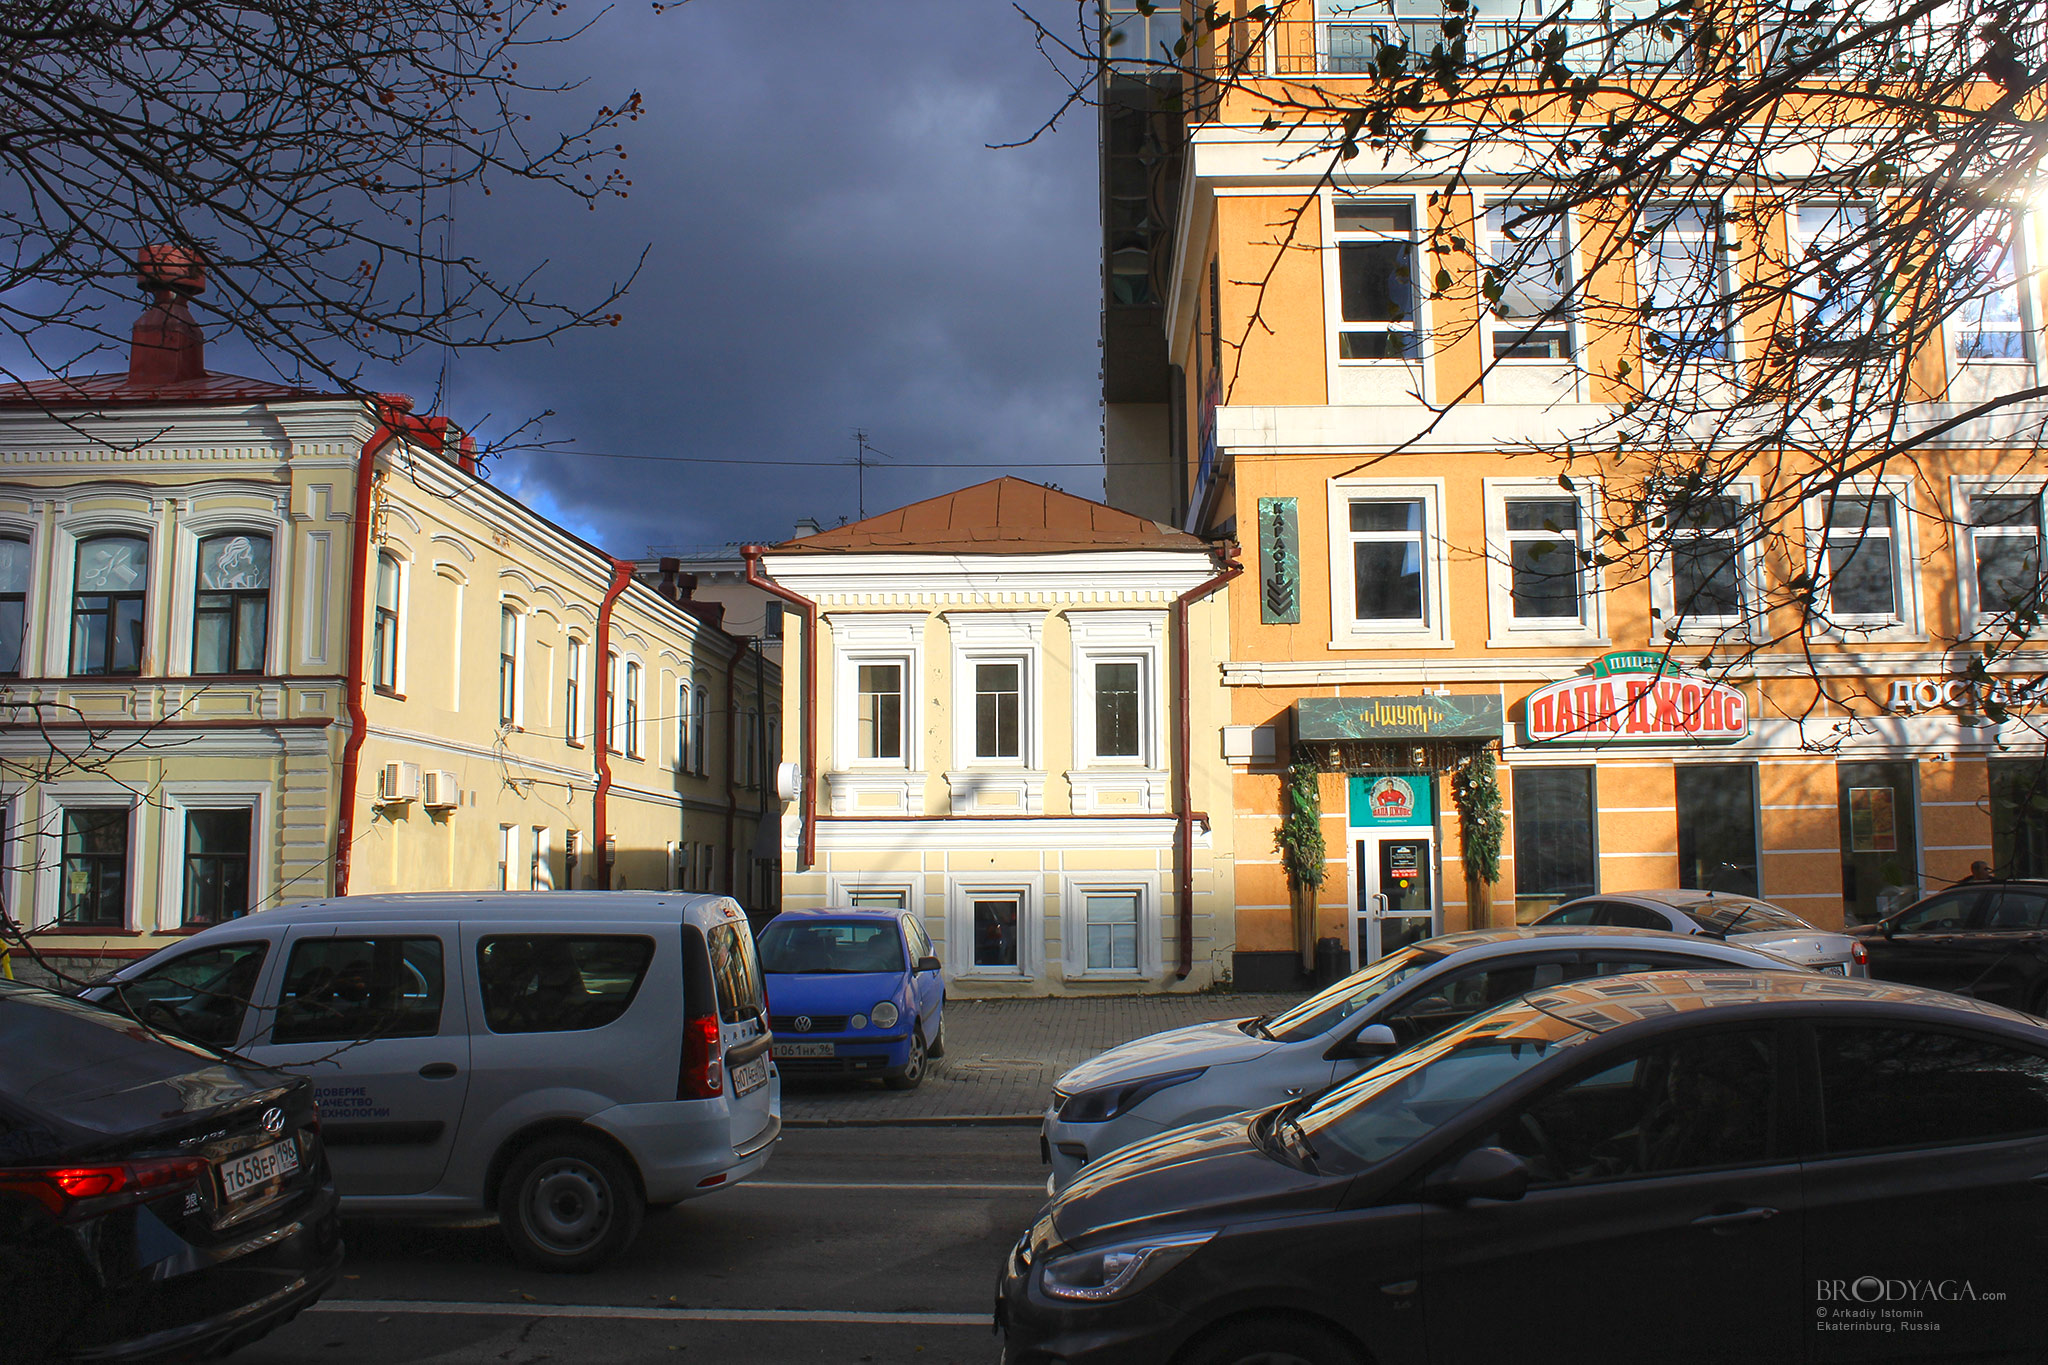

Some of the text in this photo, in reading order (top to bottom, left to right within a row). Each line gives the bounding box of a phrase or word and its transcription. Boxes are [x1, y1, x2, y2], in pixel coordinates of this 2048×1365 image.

[1273, 502, 1286, 585] КАРАОКЕ
[1533, 682, 1621, 734] ПАПА
[314, 1087, 367, 1098] ДОВЕРИЕ
[319, 1107, 390, 1118] ЕХНОЛОГИИ
[225, 1140, 296, 1191] Т658ЕР 196
